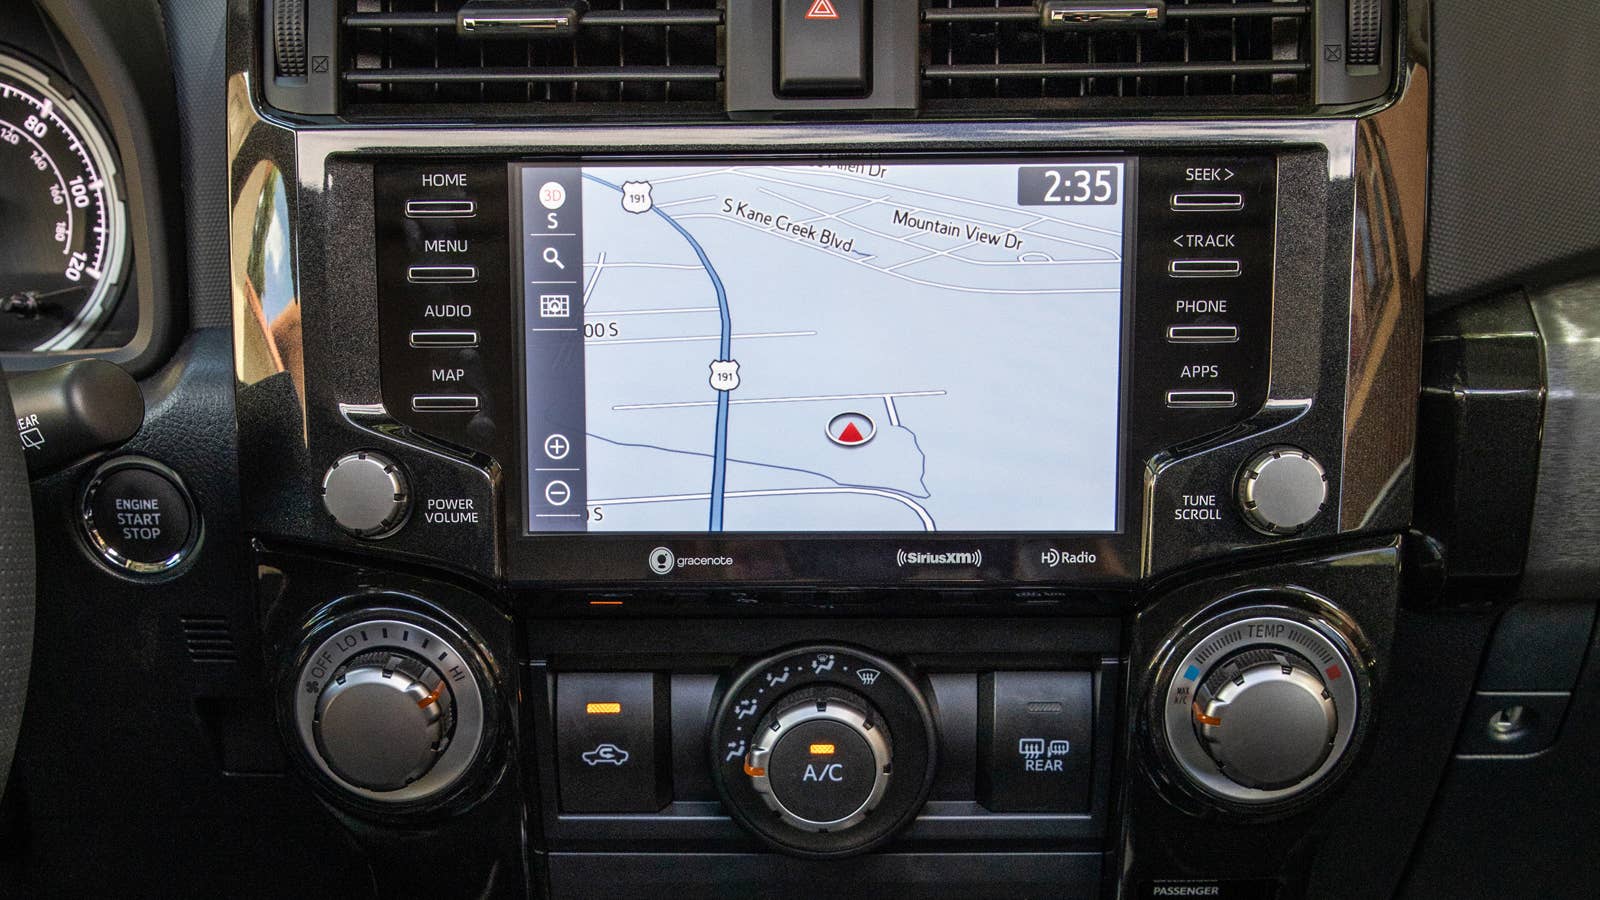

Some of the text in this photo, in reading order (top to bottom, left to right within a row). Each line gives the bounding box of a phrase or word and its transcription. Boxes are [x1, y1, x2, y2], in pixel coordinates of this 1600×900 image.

[23, 114, 48, 139] 80
[0, 126, 20, 145] 120
[29, 149, 48, 172] 140
[868, 163, 888, 178] Dr
[422, 173, 468, 188] HOME
[1043, 169, 1112, 203] 2:35
[49, 183, 64, 206] 160
[69, 174, 90, 209] 100
[544, 188, 562, 202] 3D
[629, 193, 646, 205] 191
[547, 212, 559, 230] S
[722, 198, 854, 252] S Kane Creek Blvd
[54, 221, 67, 243] 180
[892, 210, 1024, 250] Mountain View Dr
[424, 240, 469, 253] MENU
[64, 251, 88, 282] 120
[424, 304, 472, 318] AUDIO
[1175, 300, 1227, 314] PHONE
[609, 322, 619, 337] S
[431, 368, 465, 382] MAP
[716, 371, 733, 383] 191
[1180, 365, 1219, 379] APPS
[16, 414, 40, 431] EAR
[115, 499, 159, 511] ENGINE
[427, 499, 475, 511] POWER
[1182, 495, 1217, 507] TUNE
[117, 513, 161, 526] START
[424, 512, 479, 524] VOLUME
[593, 506, 603, 521] S
[1174, 508, 1222, 521] SCROLL
[123, 528, 161, 540] STOP
[676, 554, 733, 568] gracenote
[1061, 551, 1097, 564] Radio
[1247, 624, 1285, 639] TEMP
[311, 634, 358, 680] OFF LO
[449, 664, 466, 683] HI
[1025, 759, 1063, 773] REAR
[803, 765, 843, 784] A/C
[1153, 886, 1220, 896] PASSENGER
